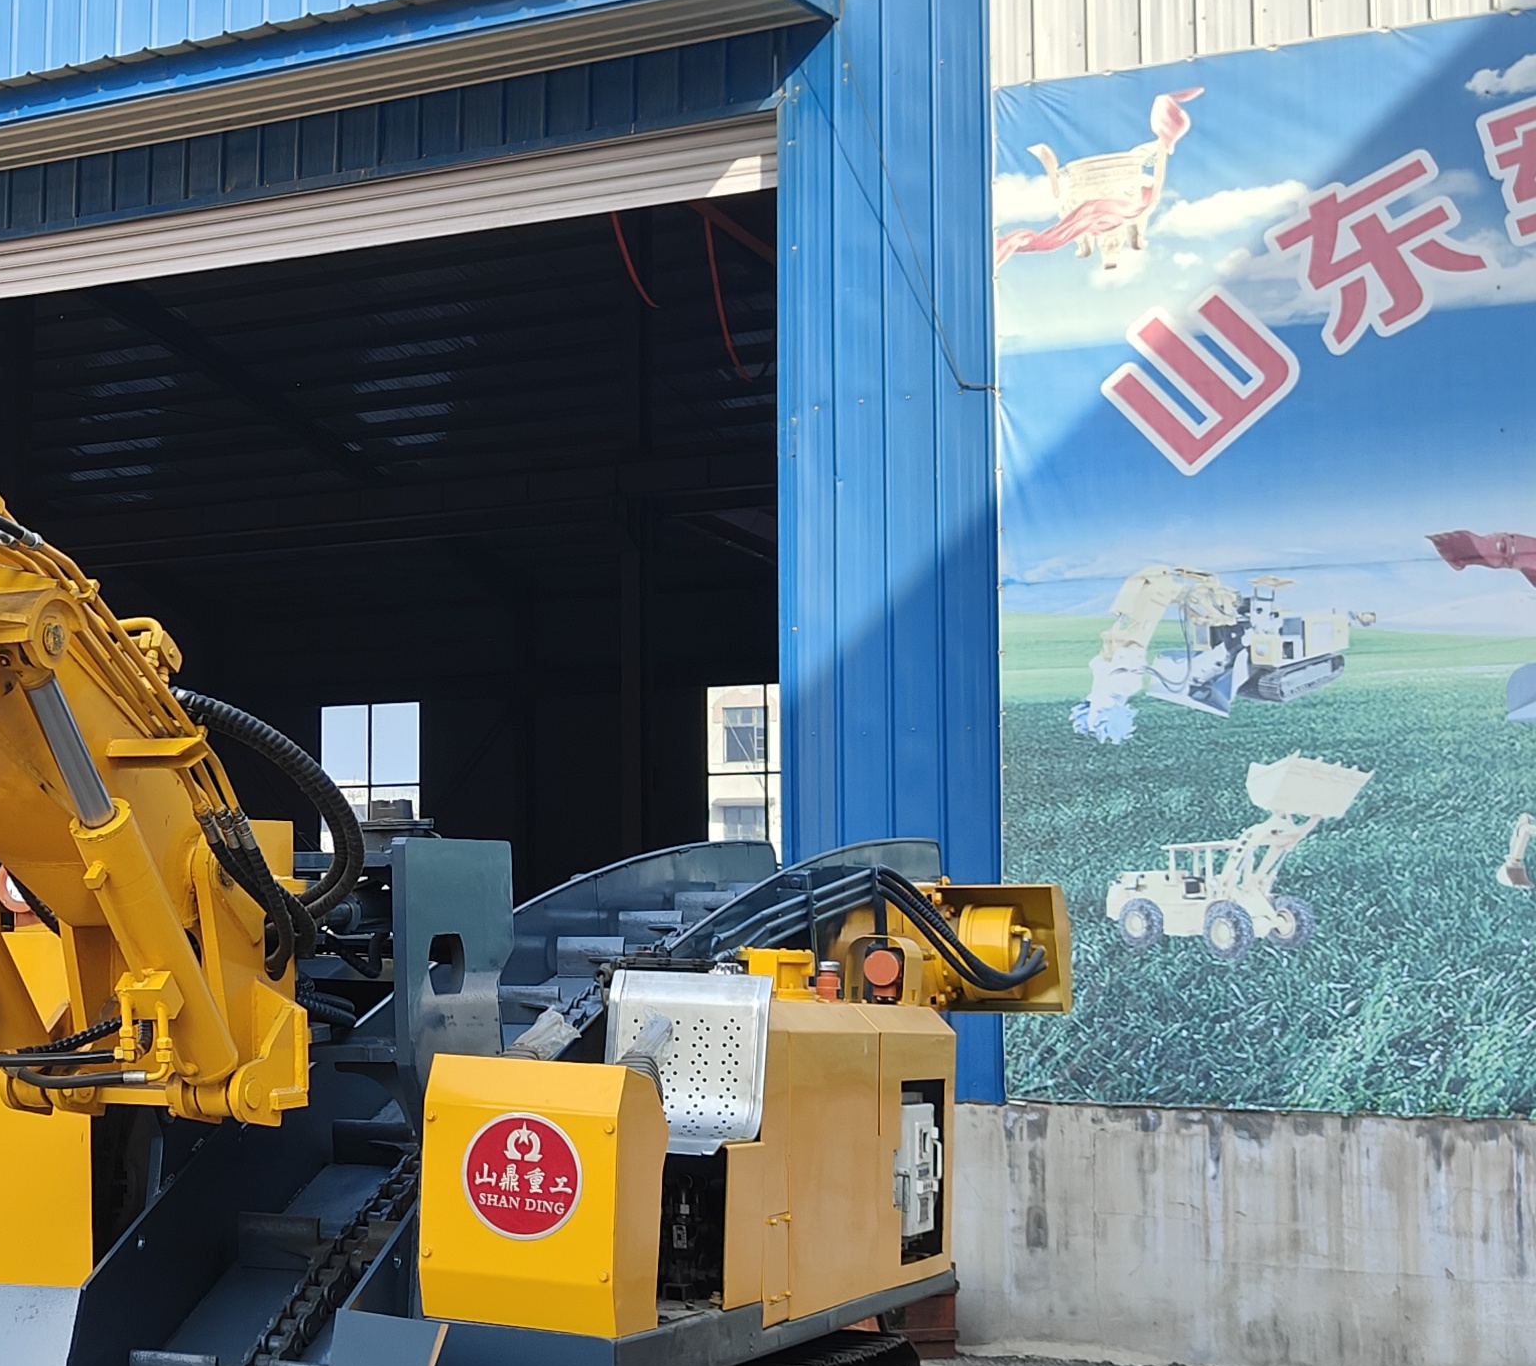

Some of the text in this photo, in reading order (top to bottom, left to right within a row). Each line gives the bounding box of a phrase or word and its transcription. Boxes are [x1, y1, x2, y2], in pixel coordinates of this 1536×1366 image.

[1107, 99, 1536, 471] 山东
[474, 1162, 573, 1194] 山鼎重工
[478, 1192, 566, 1215] SHAN DING
